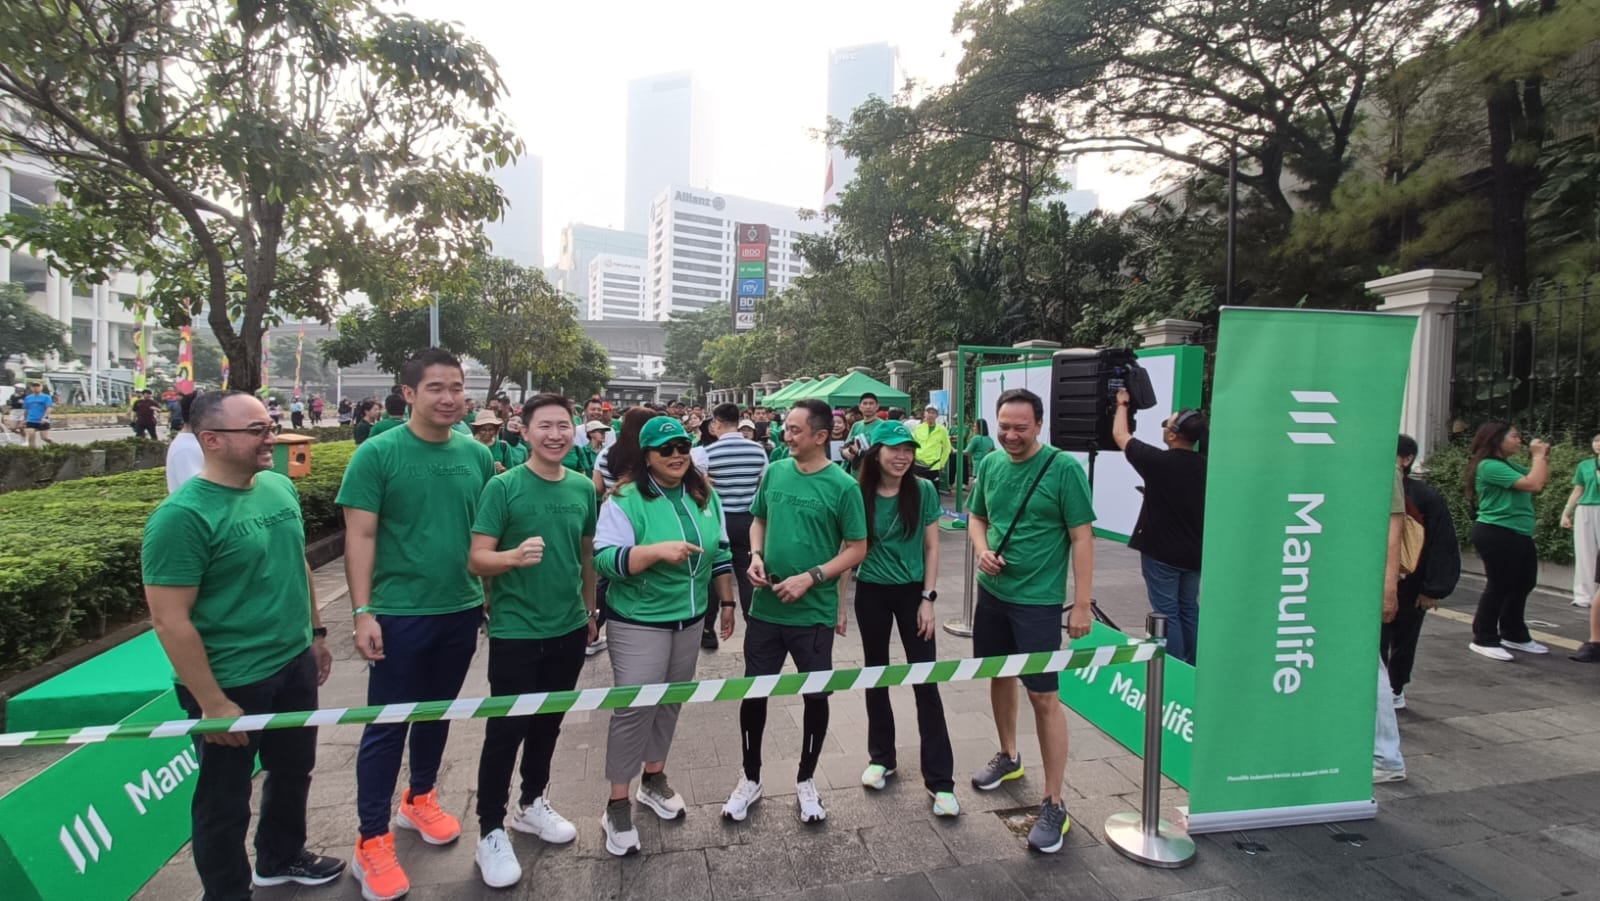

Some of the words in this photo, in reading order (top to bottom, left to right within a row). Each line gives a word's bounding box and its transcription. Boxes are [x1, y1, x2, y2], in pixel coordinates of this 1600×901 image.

[675, 190, 711, 207] Allianz
[1273, 493, 1325, 694] Manulife
[1109, 672, 1194, 743] Malife
[124, 743, 200, 815] Manu
